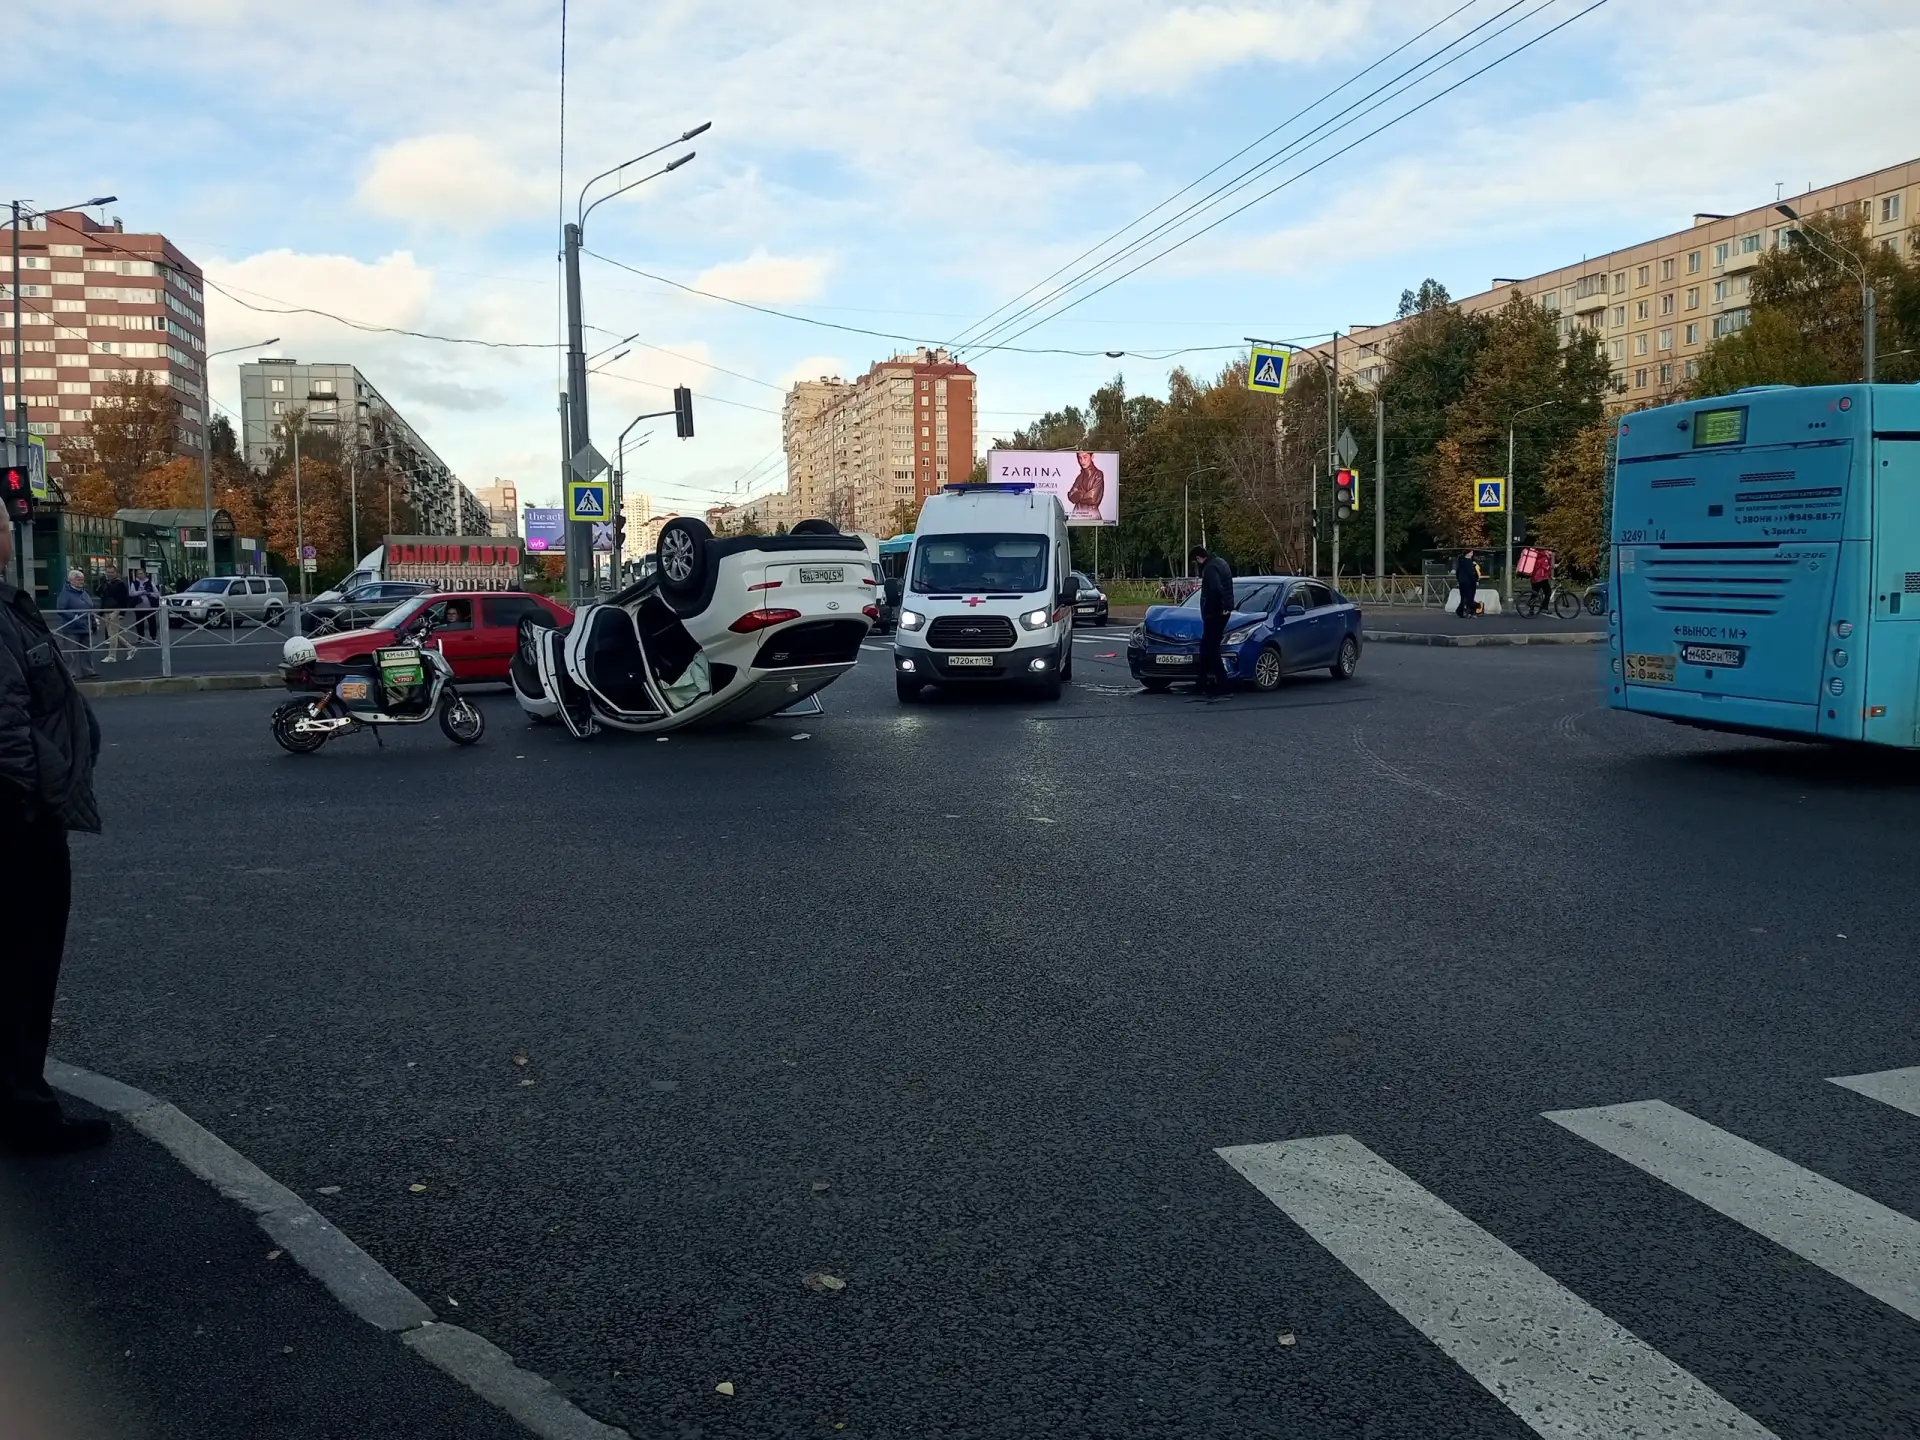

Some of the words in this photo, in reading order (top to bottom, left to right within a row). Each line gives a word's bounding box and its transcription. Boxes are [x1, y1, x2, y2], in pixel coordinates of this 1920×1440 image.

[1001, 466, 1061, 477] ZARINA
[529, 511, 546, 521] the
[1742, 515, 1772, 524] ЗВОНИ
[1621, 530, 1647, 542] 32491
[531, 540, 545, 548] wb
[388, 544, 462, 565] ВЫКУП
[467, 545, 520, 566] АВТО
[1682, 625, 1718, 638] ВЫНОС
[1720, 627, 1726, 639] 1
[1729, 628, 1739, 639] М
